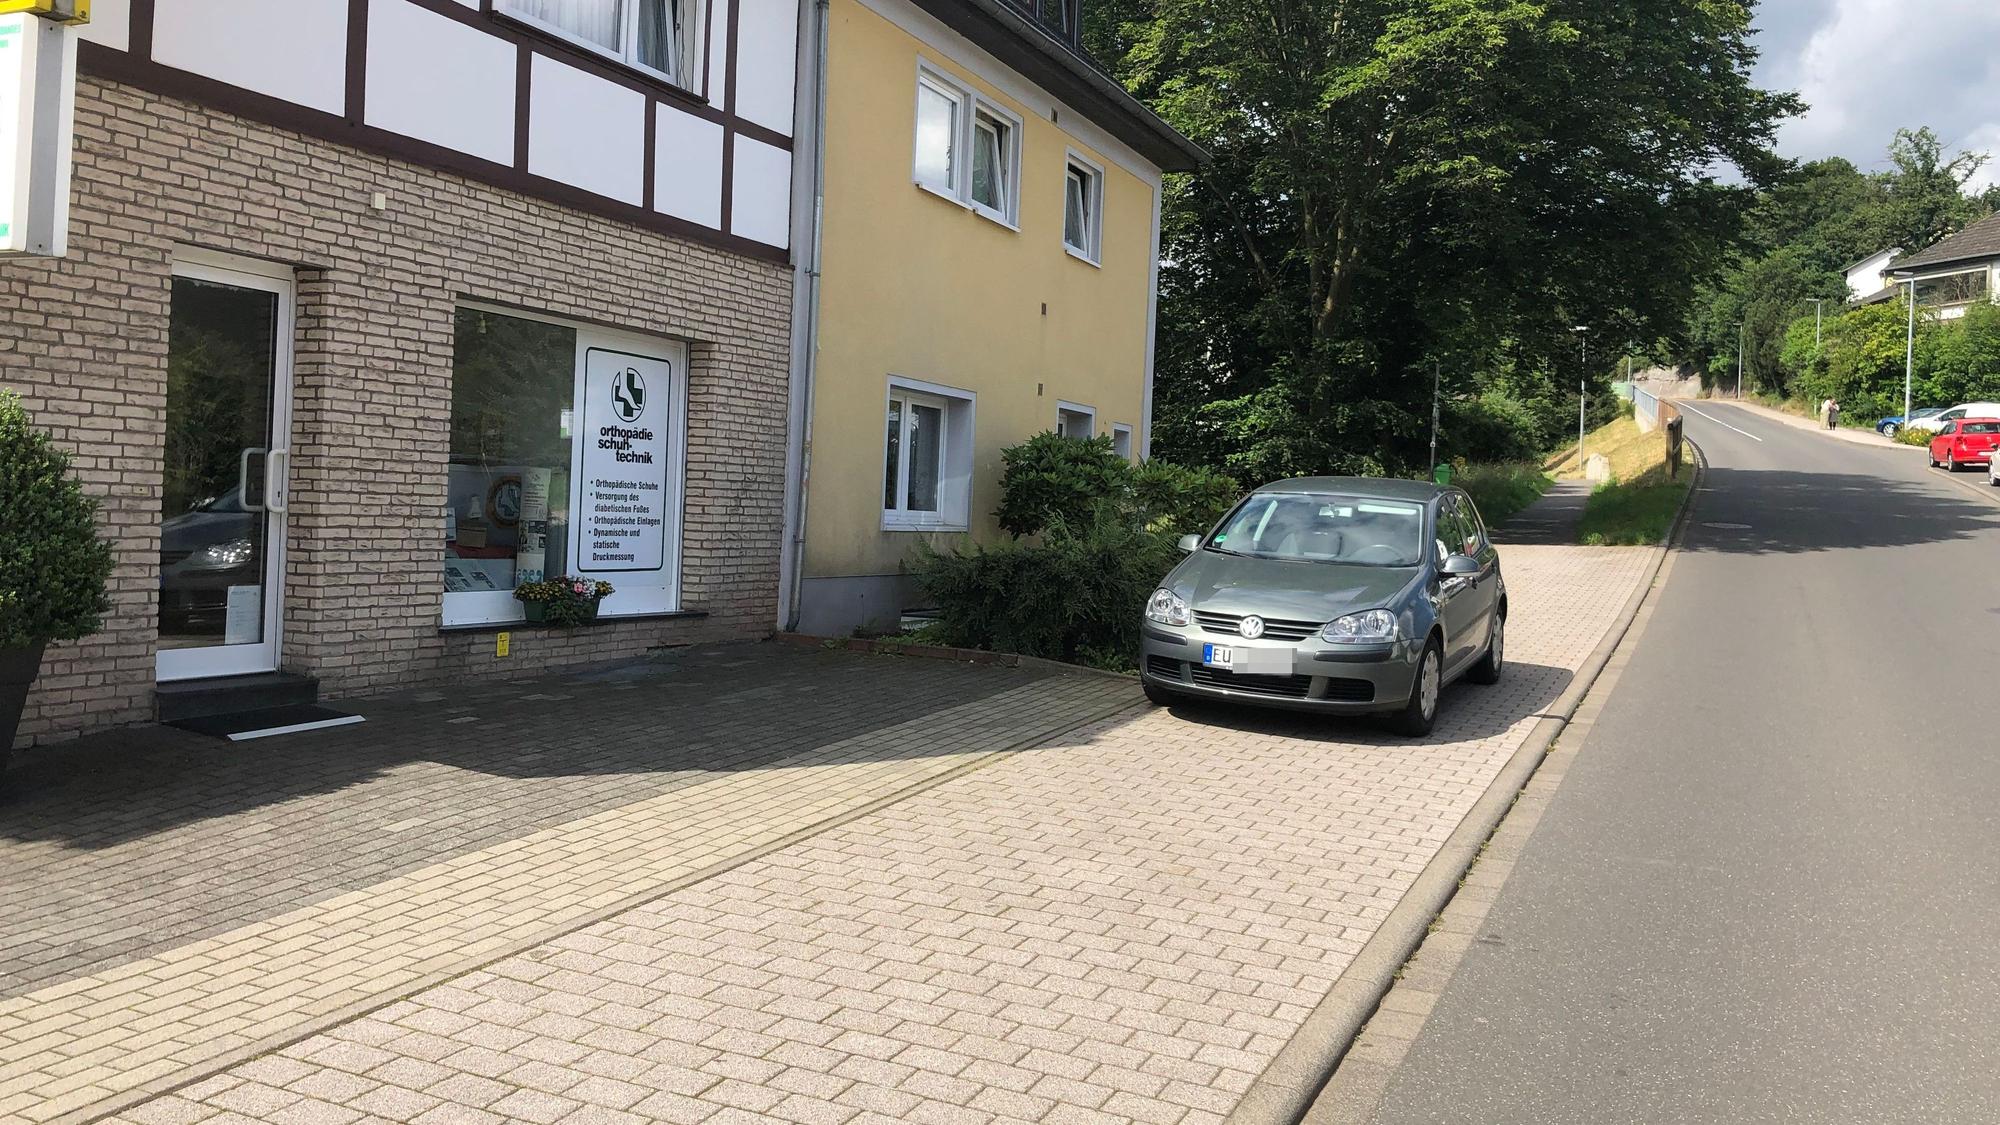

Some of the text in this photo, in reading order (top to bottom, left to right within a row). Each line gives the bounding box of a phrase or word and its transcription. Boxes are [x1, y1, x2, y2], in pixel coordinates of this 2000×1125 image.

[600, 425, 653, 441] orthopädie
[598, 438, 632, 450] schuh-
[615, 450, 653, 464] technik
[595, 479, 659, 490] Orthopädische Schuhe
[595, 491, 640, 502] Versorgung des
[594, 504, 632, 513] diabetischen
[594, 515, 661, 527] Orthopädische Einlagen
[593, 528, 641, 538] Dynamische und
[592, 540, 620, 549] statische
[592, 552, 635, 562] Druckmessung
[1213, 648, 1232, 663] EU
